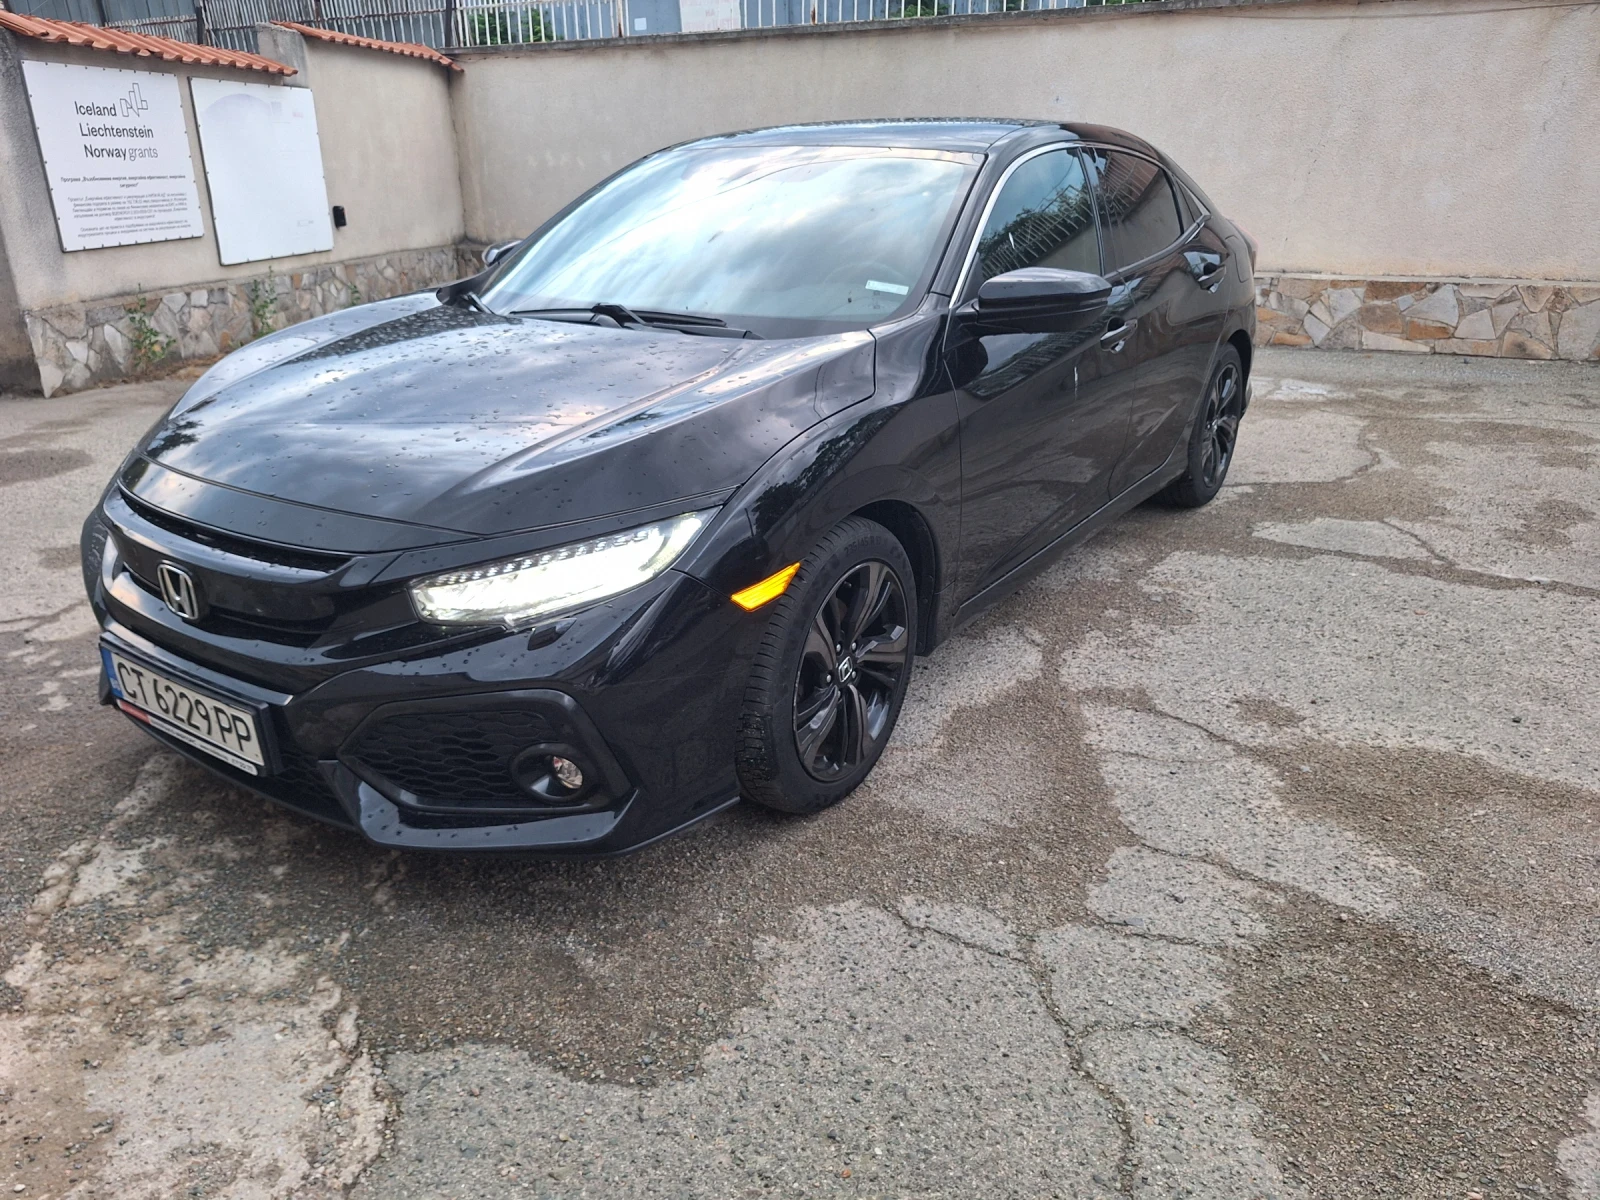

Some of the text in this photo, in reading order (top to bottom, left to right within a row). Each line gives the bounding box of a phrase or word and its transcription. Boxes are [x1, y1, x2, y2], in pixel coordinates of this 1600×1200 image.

[74, 100, 117, 117] Iceland
[79, 122, 154, 138] Liechtenstein
[84, 144, 158, 161] Norway grants
[153, 677, 212, 736] 6229
